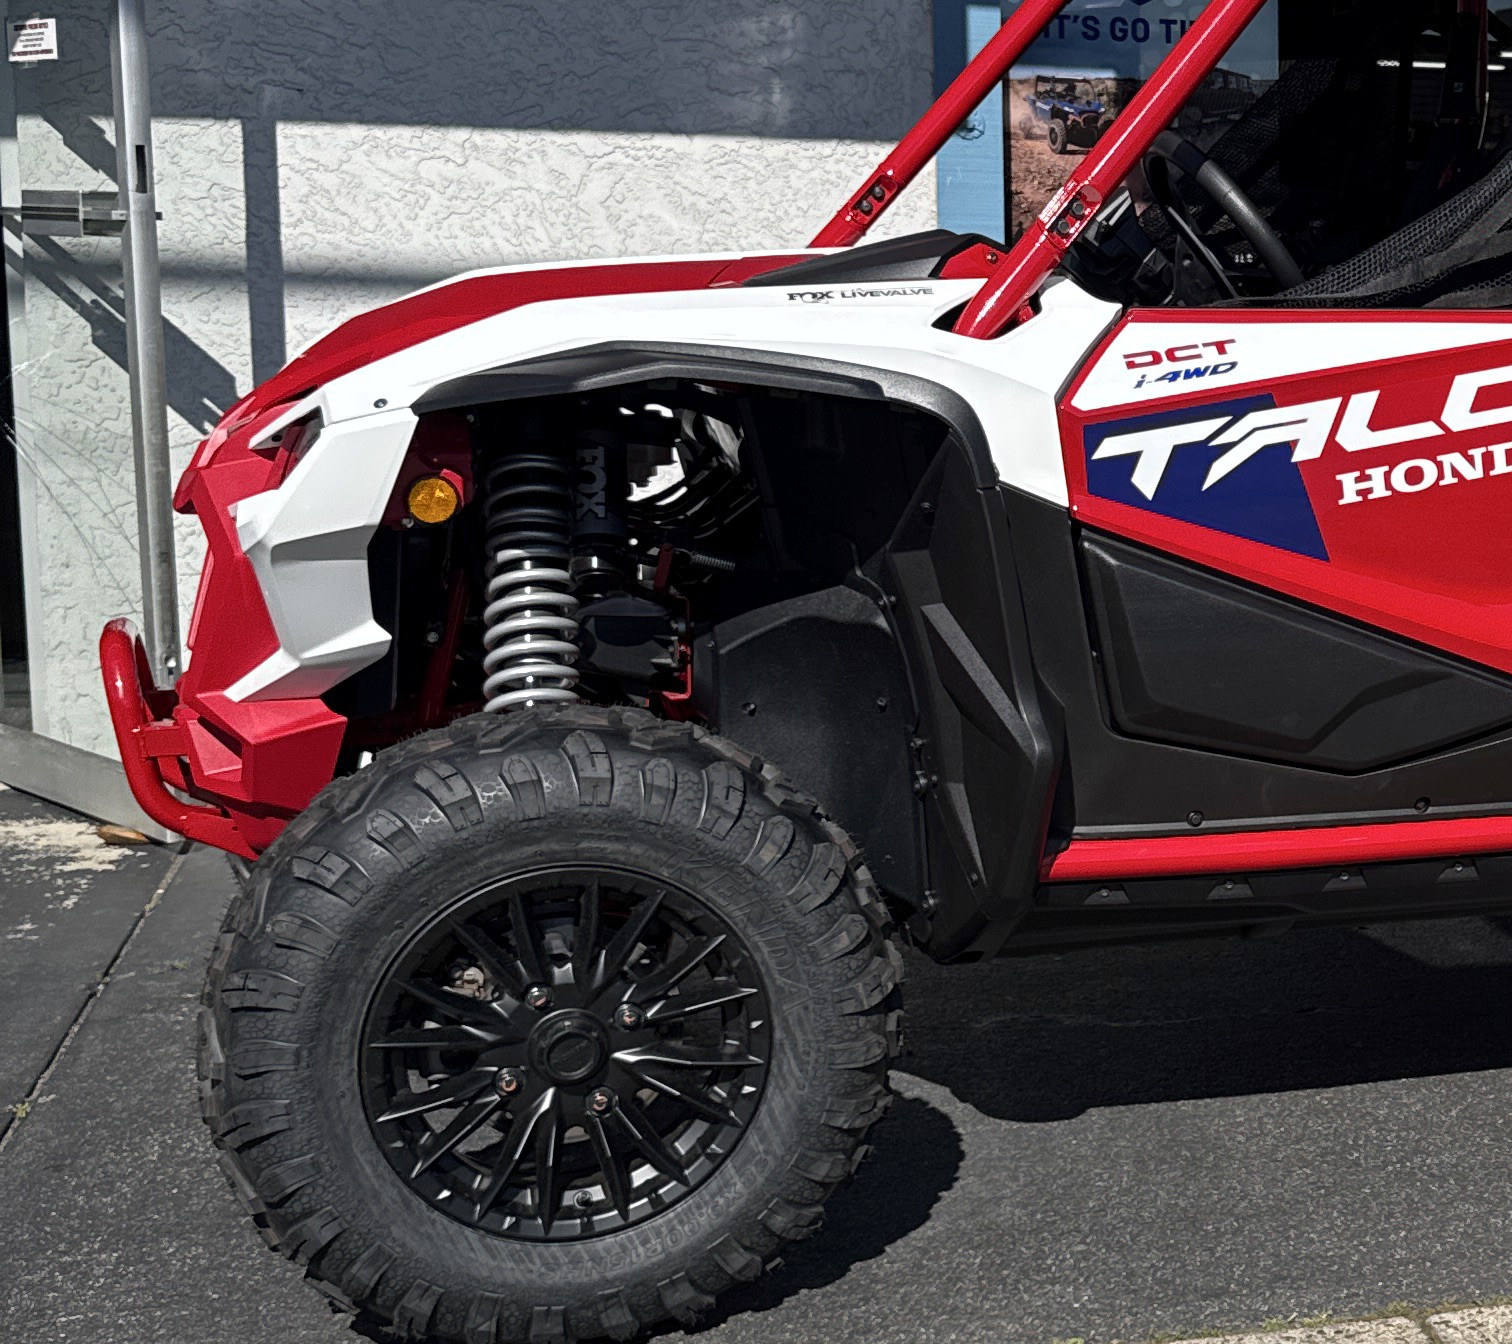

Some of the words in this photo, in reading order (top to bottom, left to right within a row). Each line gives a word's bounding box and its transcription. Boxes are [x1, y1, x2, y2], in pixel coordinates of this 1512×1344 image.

[1109, 16, 1150, 43] GO
[1158, 18, 1197, 44] TI
[786, 290, 836, 305] FOX
[1122, 338, 1237, 370] DCT
[1133, 360, 1239, 390] i-4WD
[658, 846, 813, 1013] KENDA
